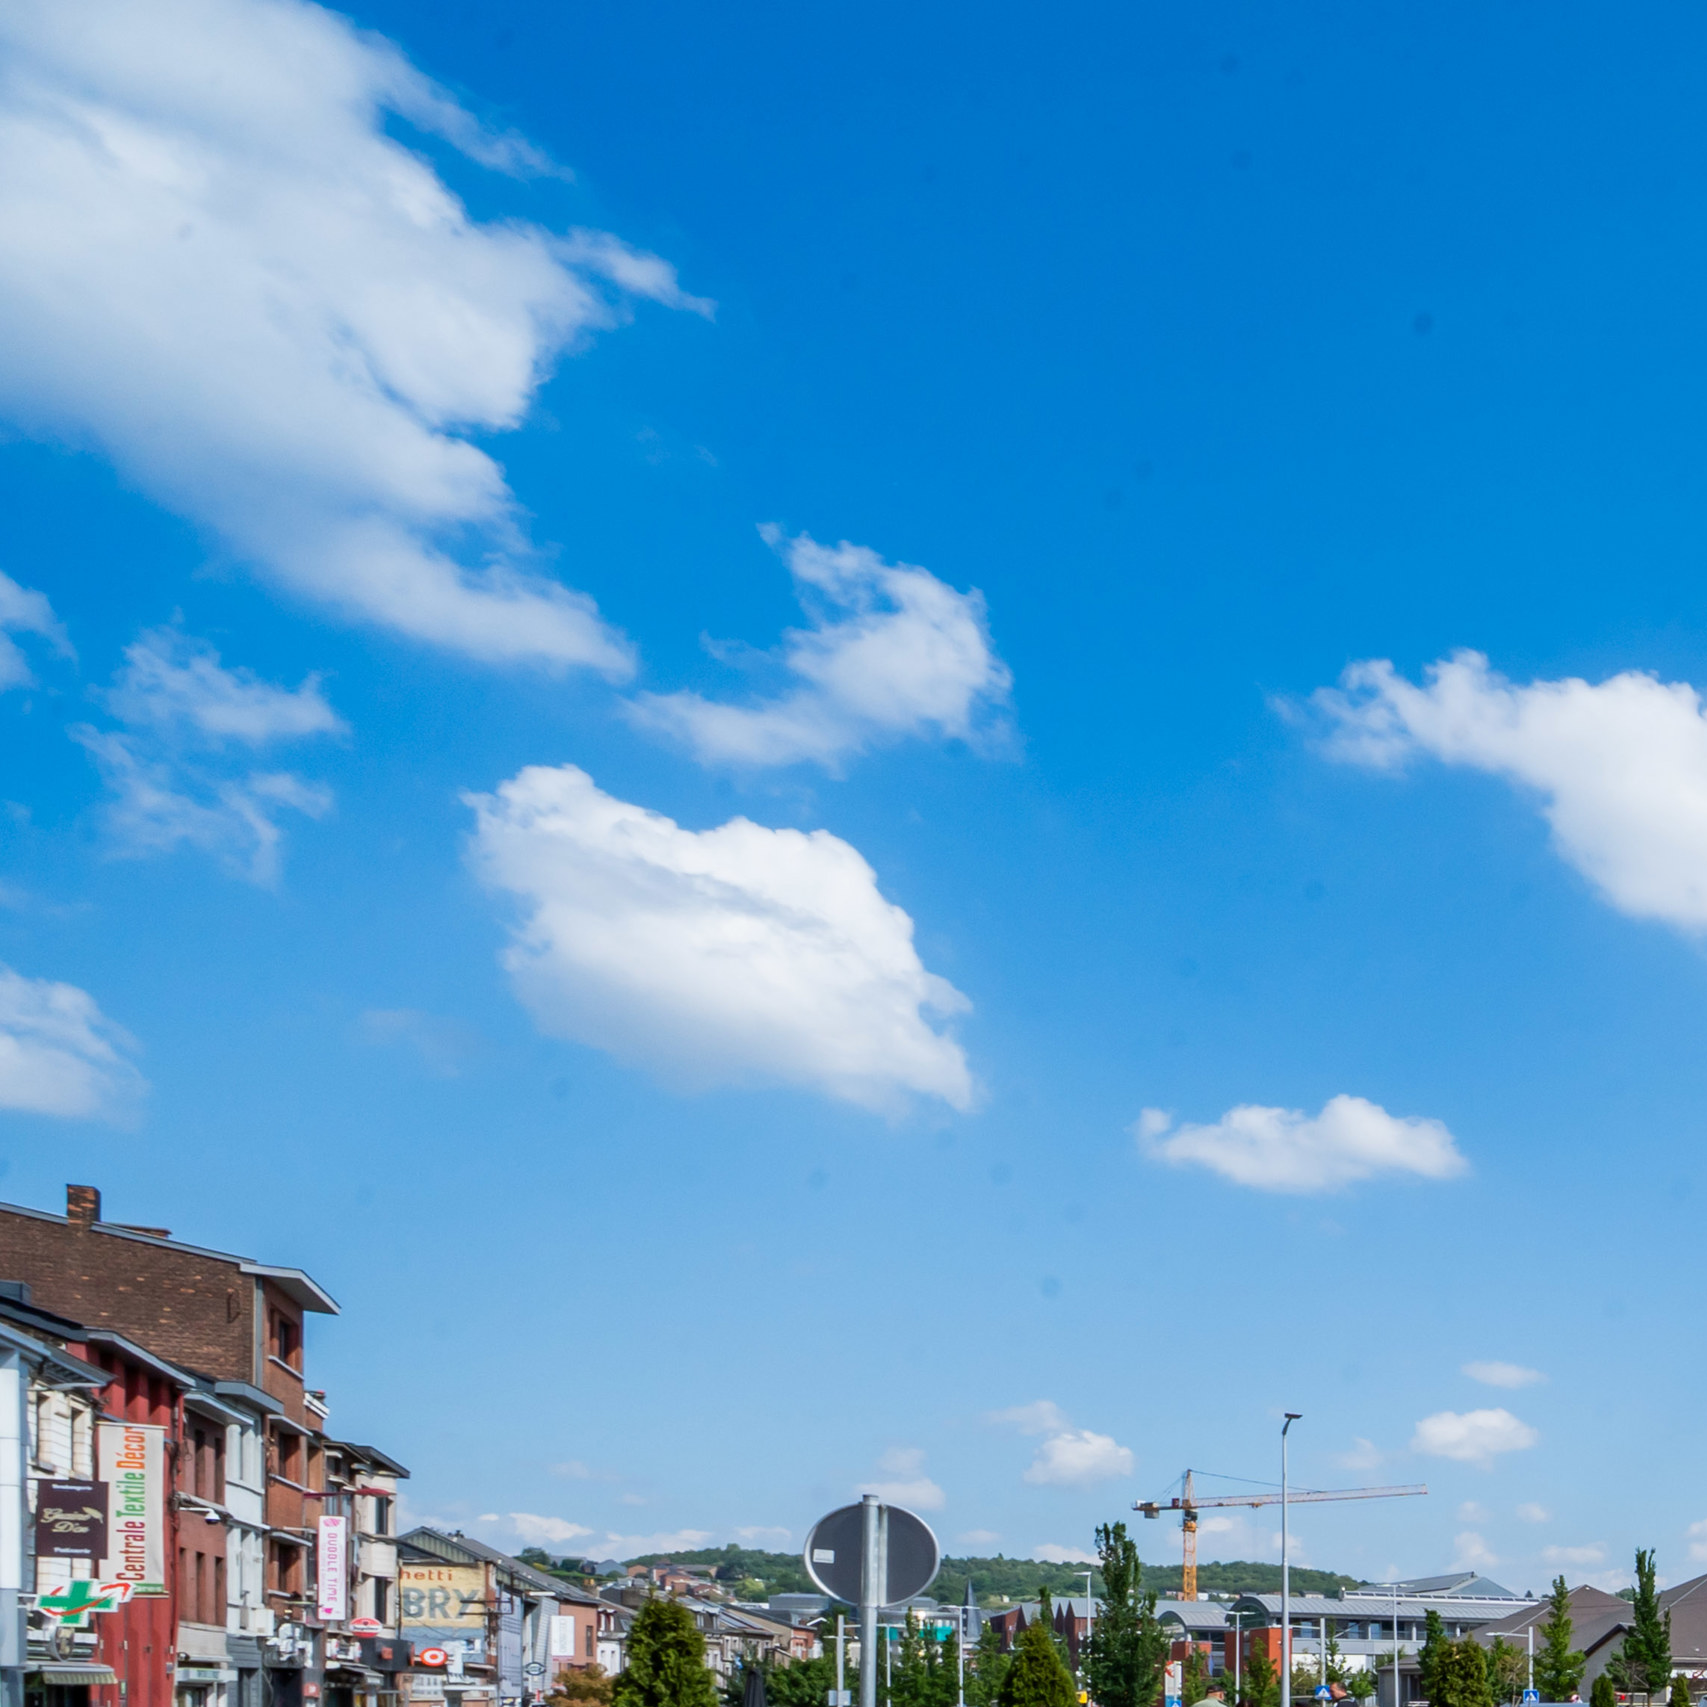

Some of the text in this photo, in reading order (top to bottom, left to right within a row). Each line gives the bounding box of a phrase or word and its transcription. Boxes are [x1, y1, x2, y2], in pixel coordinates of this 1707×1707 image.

[116, 1427, 146, 1581] Centrale Textile Décor
[327, 1577, 338, 1602] TIME
